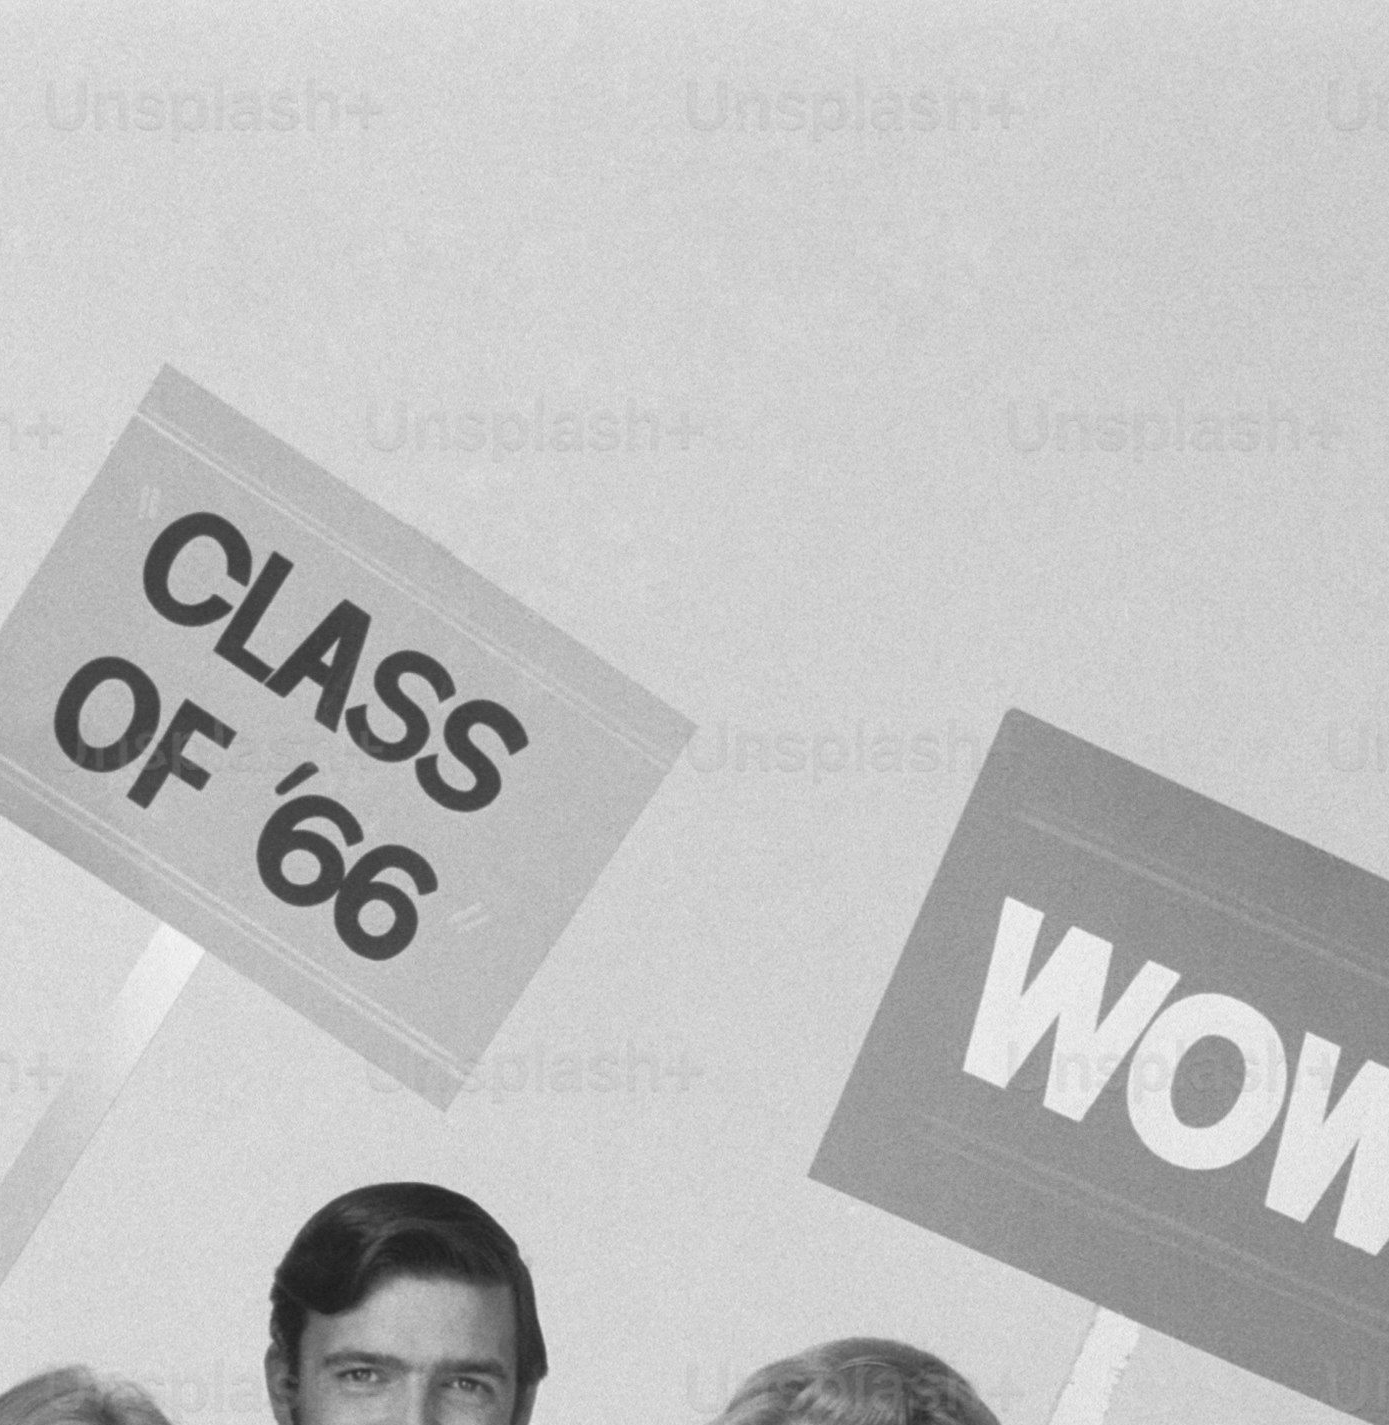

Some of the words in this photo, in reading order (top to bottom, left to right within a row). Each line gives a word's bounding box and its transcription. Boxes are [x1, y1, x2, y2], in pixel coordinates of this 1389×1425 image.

[53, 655, 236, 808] OF
[256, 762, 438, 961] '66
[143, 512, 528, 812] CLASS
